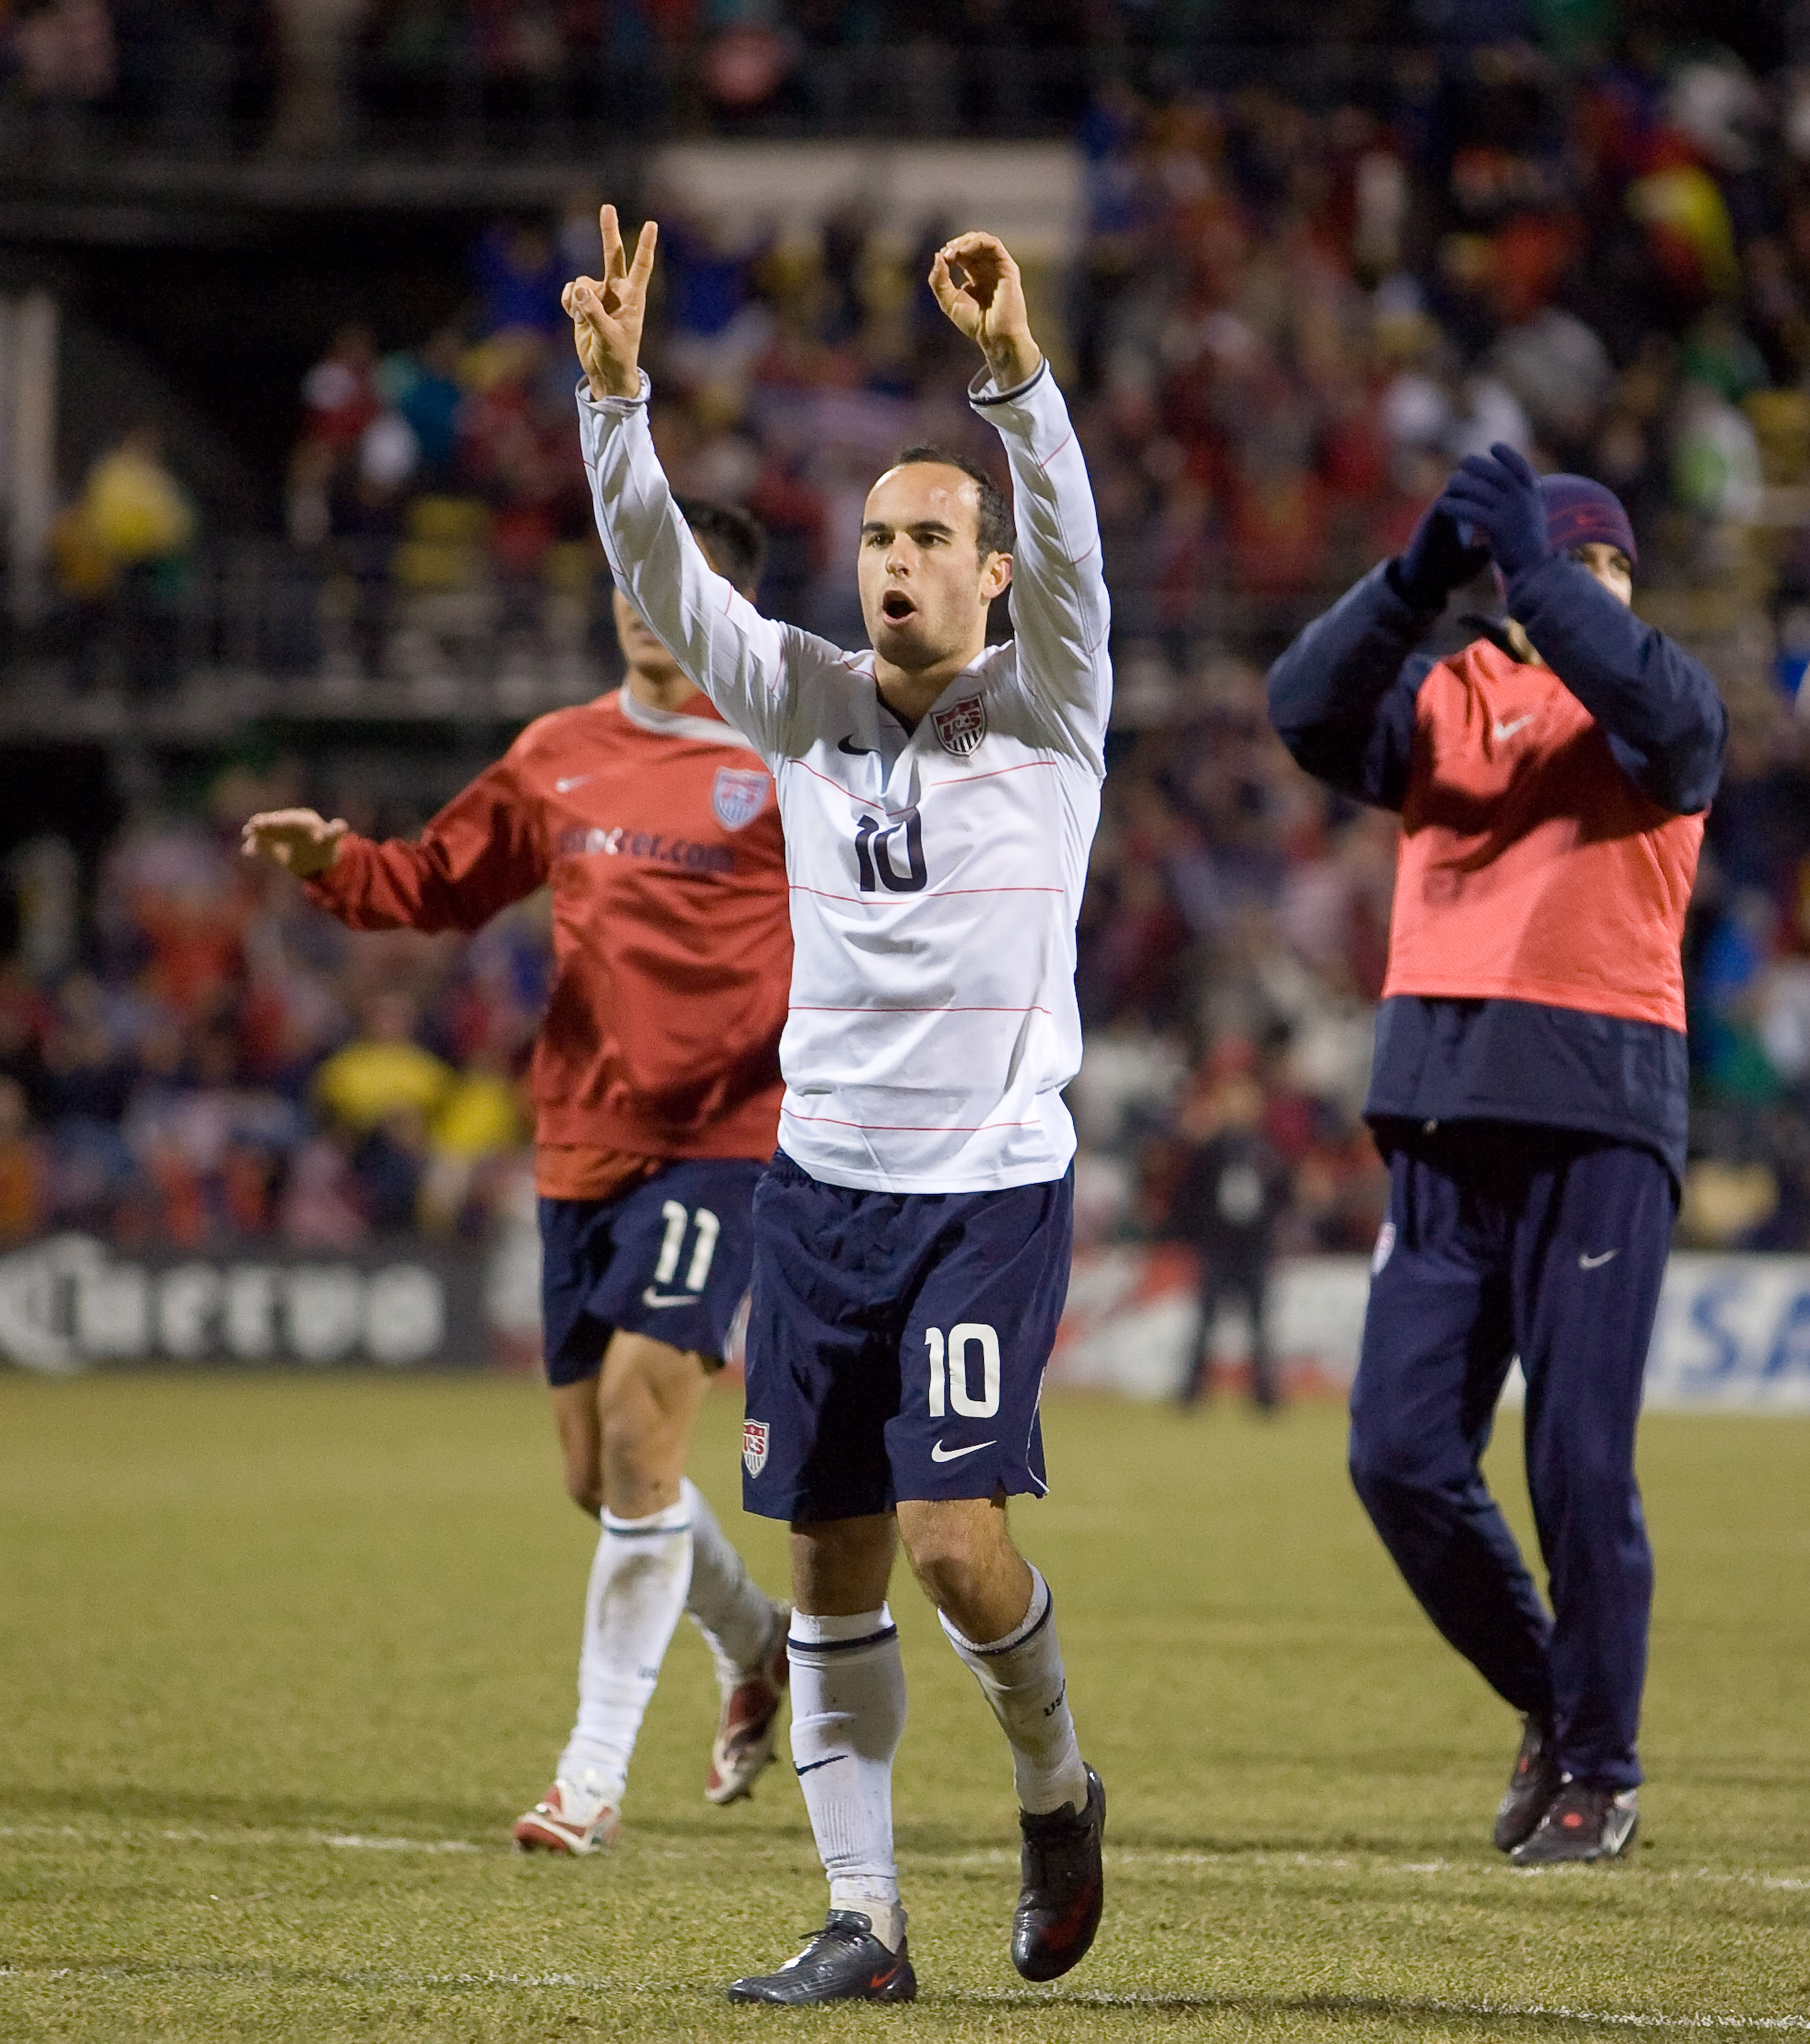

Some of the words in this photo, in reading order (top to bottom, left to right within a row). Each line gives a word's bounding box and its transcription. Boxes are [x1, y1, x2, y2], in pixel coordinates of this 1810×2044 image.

[854, 806, 928, 893] 10
[653, 1199, 721, 1292] 11
[924, 1322, 1001, 1418] 10
